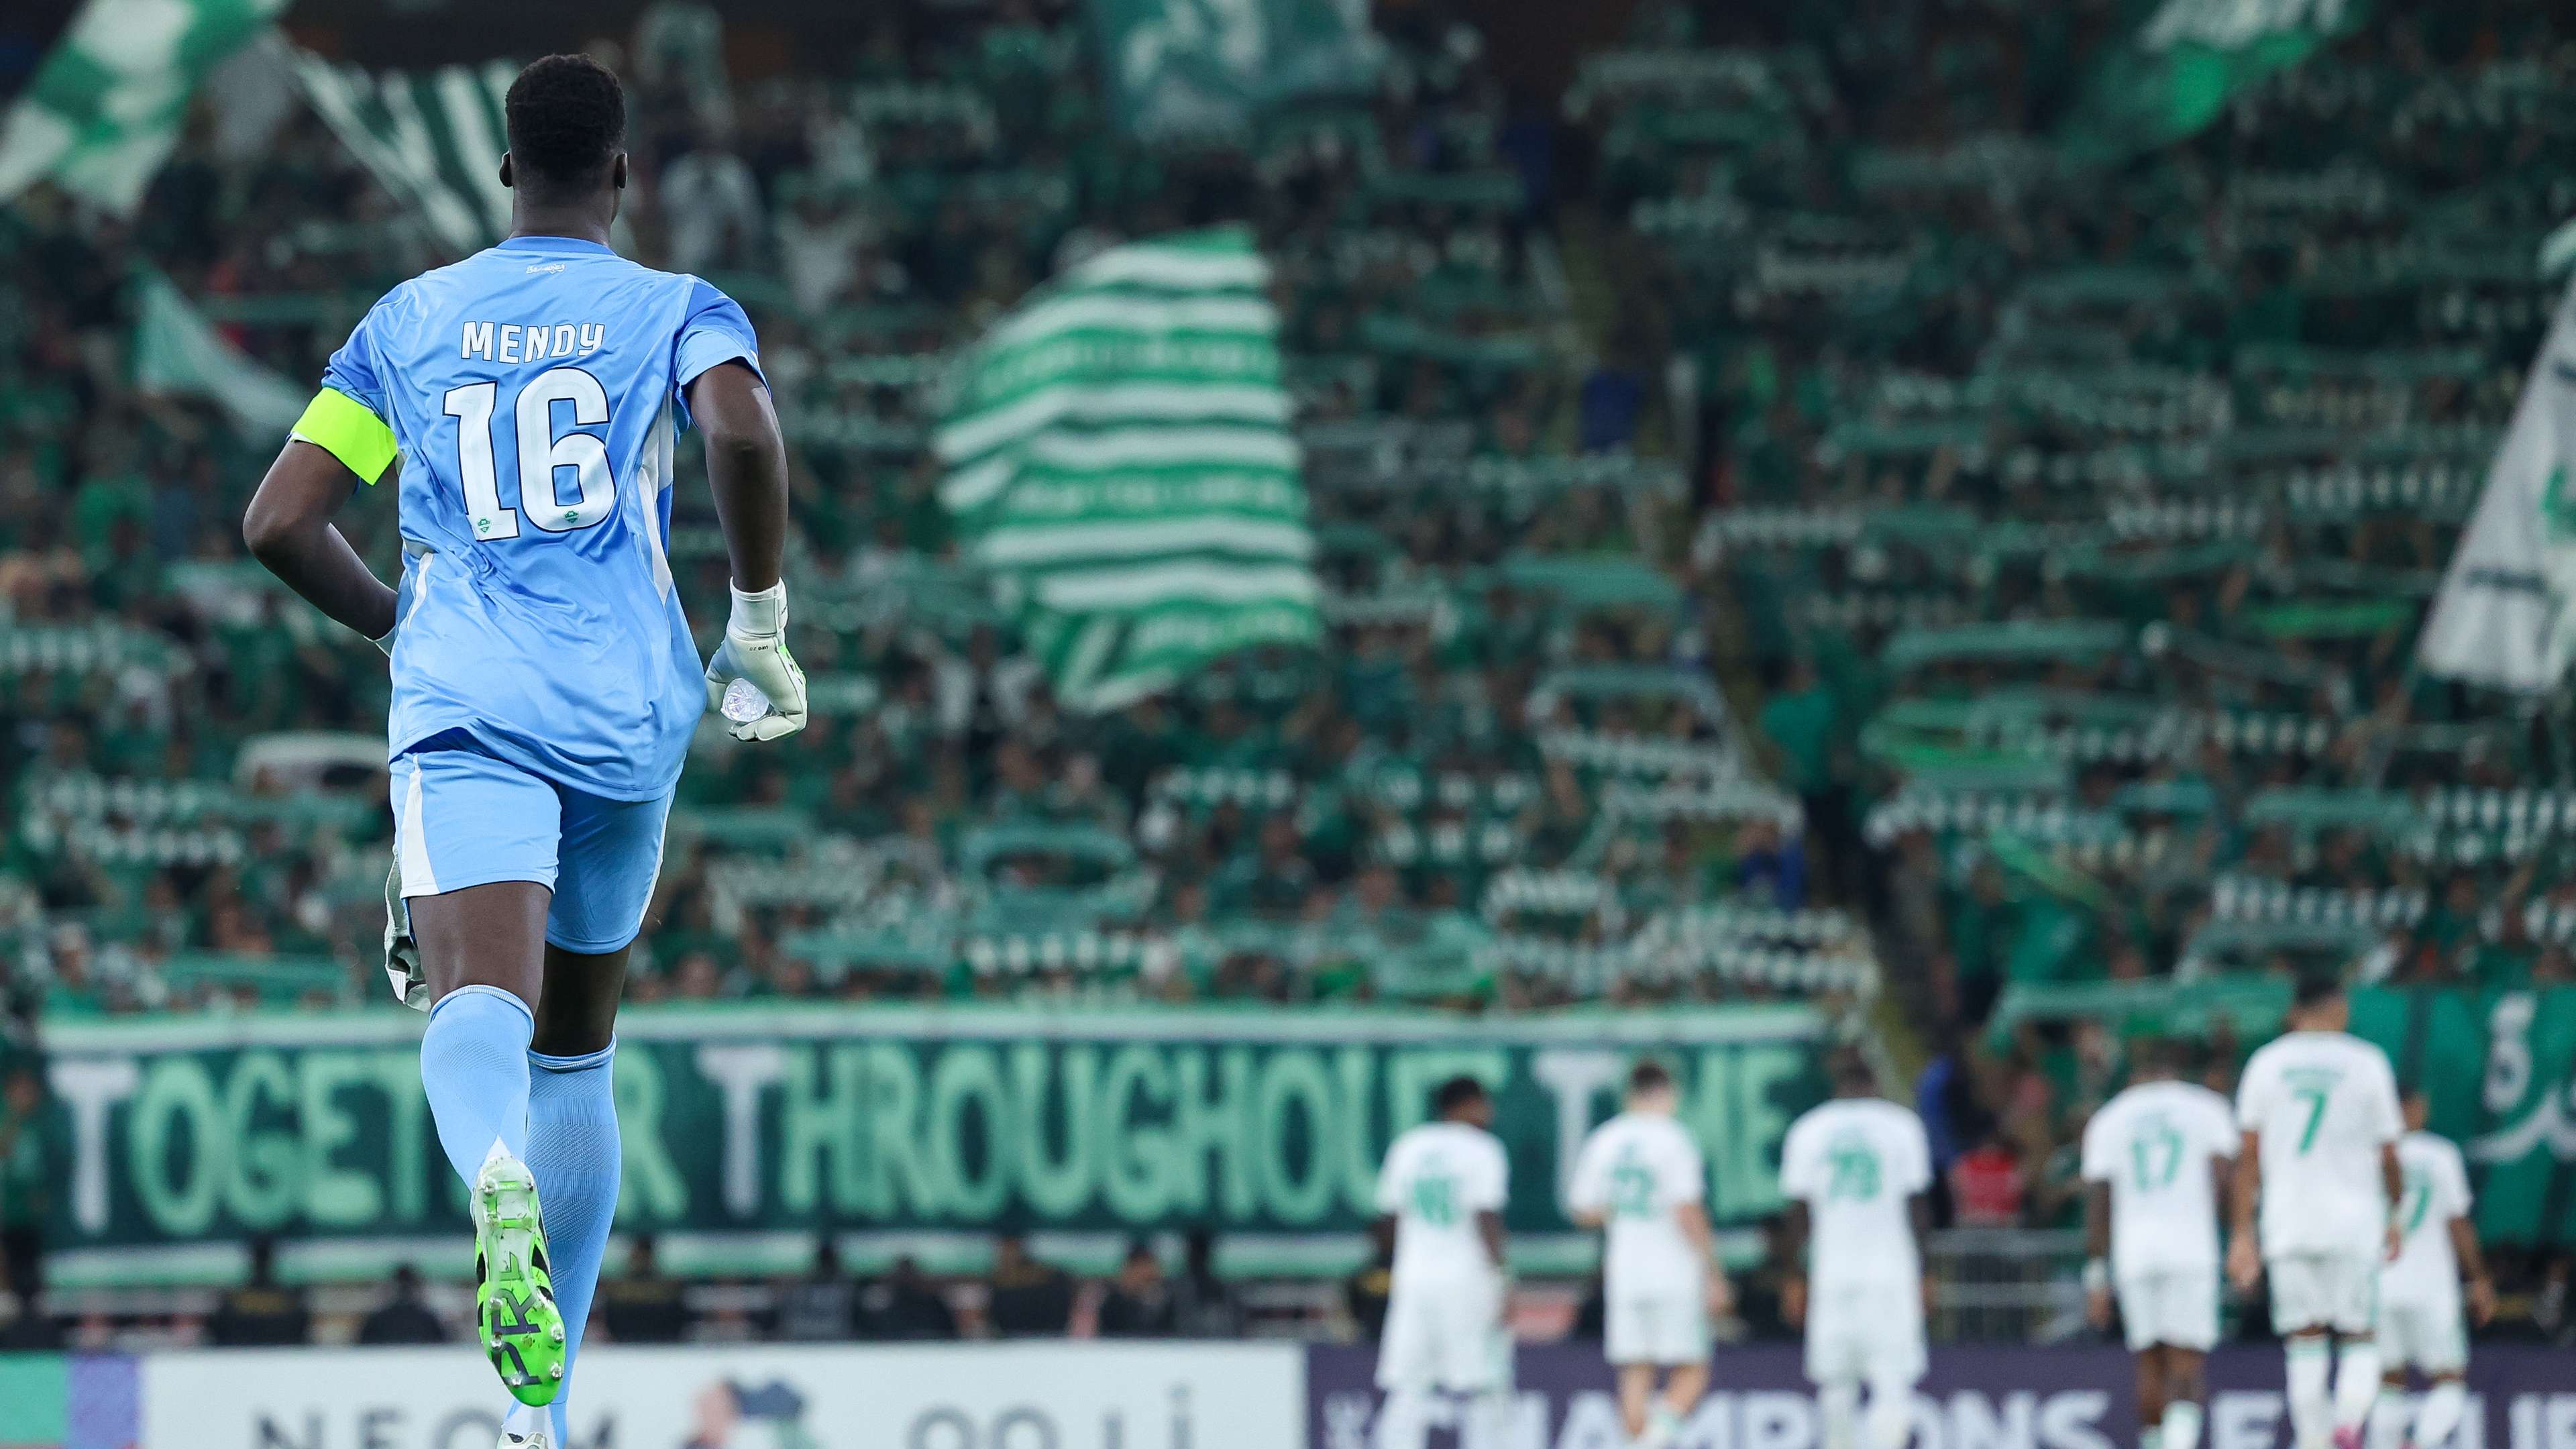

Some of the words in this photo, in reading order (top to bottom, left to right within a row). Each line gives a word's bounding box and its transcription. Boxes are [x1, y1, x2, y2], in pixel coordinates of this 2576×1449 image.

[461, 321, 605, 364] MENDY
[442, 366, 615, 542] 16
[48, 1048, 690, 1236] TOGETR
[2292, 1085, 2329, 1158] 7
[2128, 1127, 2185, 1192] 17
